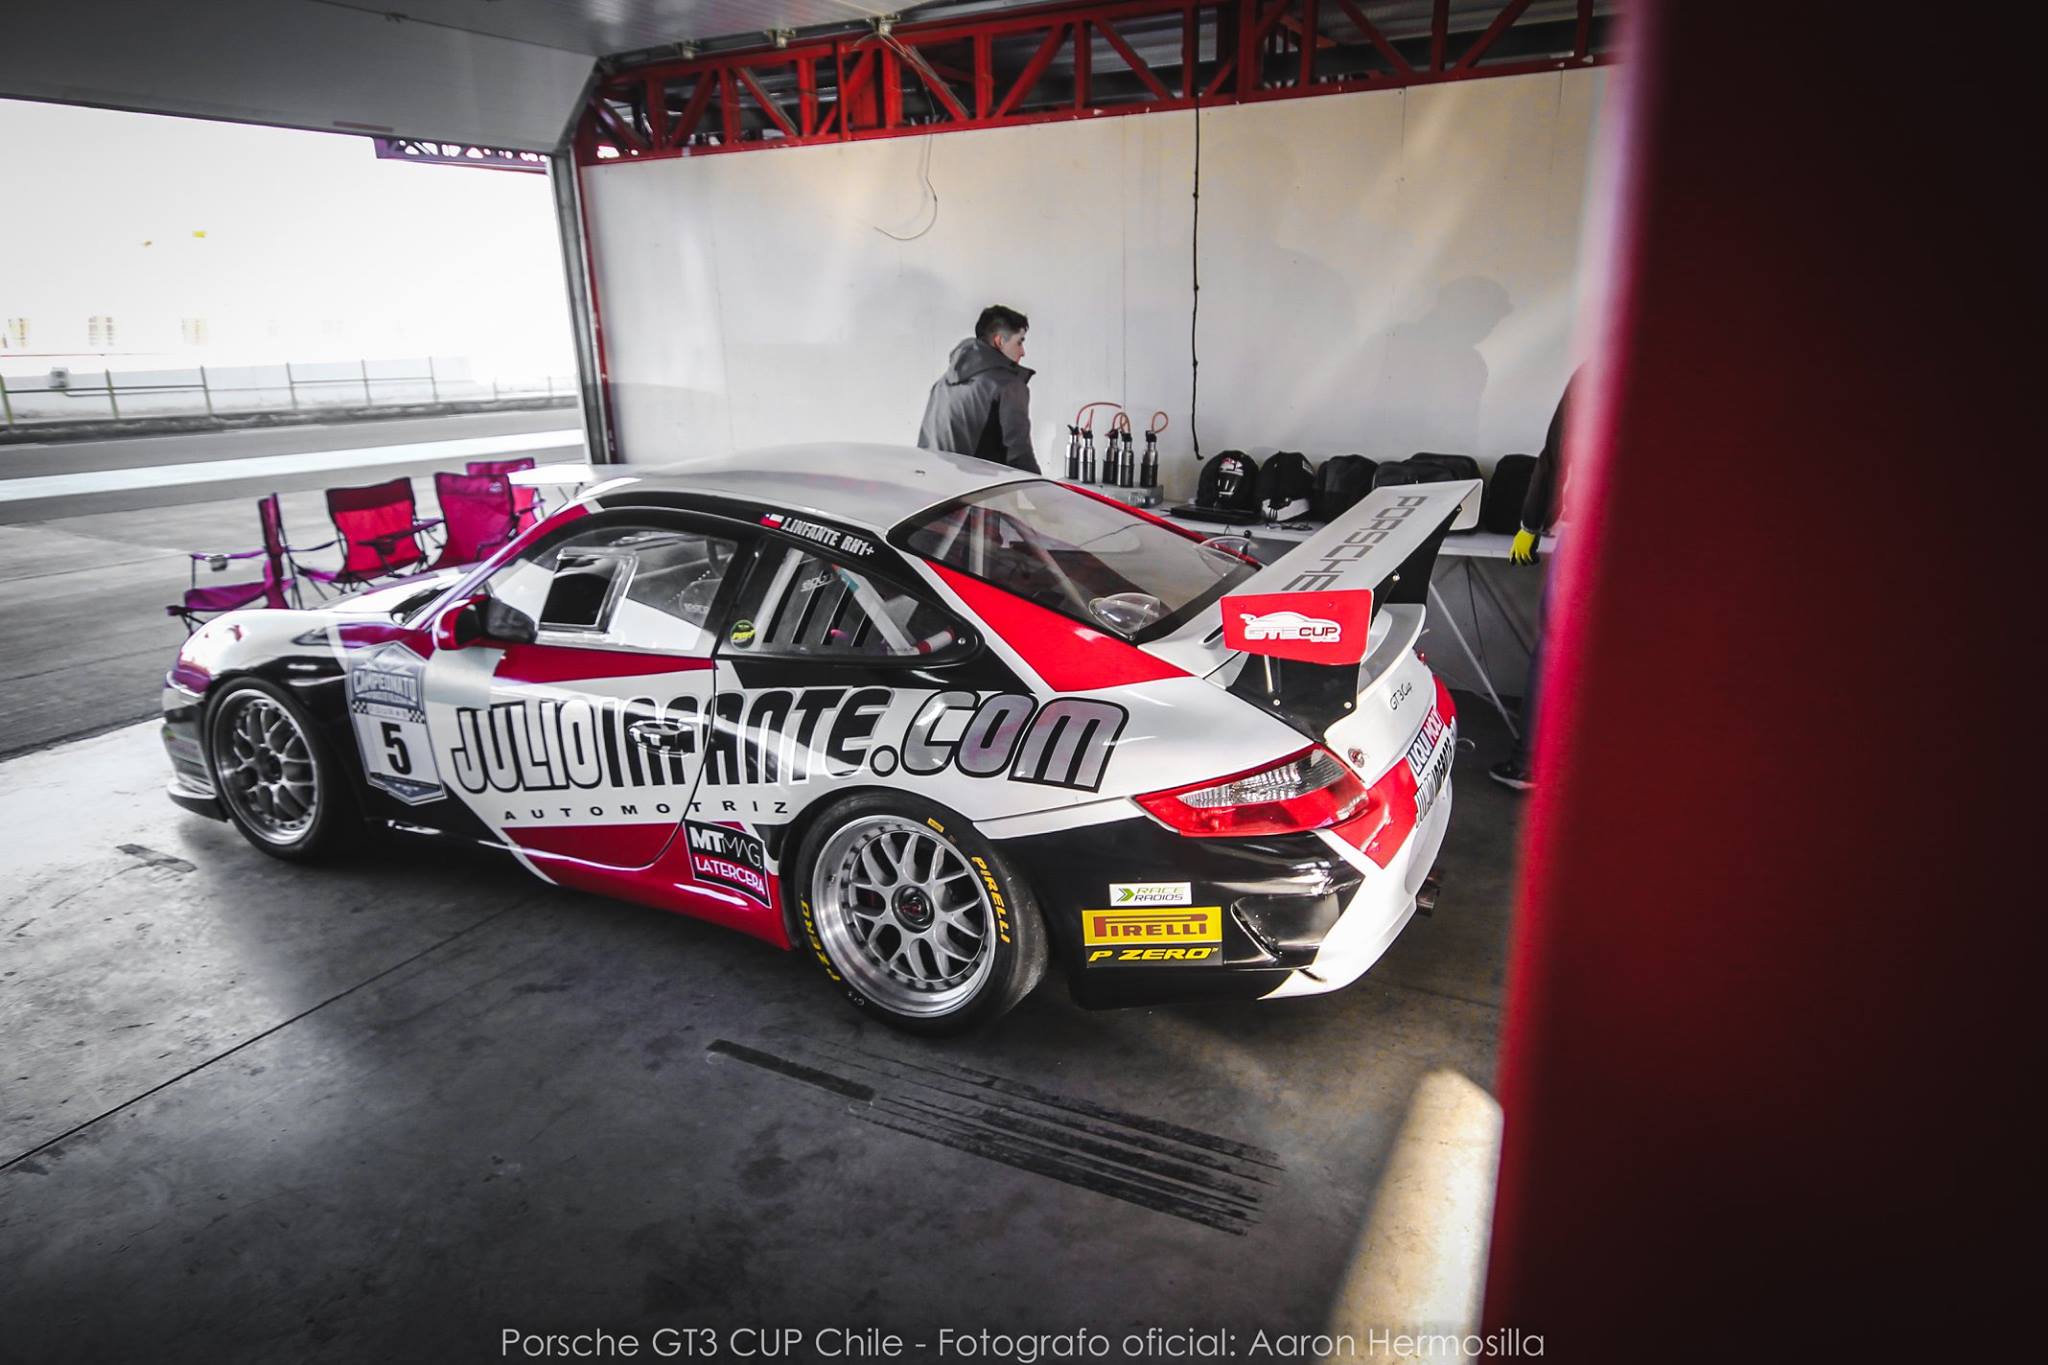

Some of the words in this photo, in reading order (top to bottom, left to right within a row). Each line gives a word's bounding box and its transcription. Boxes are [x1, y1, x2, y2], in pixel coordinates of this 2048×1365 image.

[1281, 496, 1428, 591] PORSCHE
[380, 721, 412, 775] 5
[504, 800, 789, 821] AUTOMOTRIZ
[971, 855, 1011, 944] PIRELLI
[1134, 894, 1183, 902] RADIOS
[1094, 914, 1208, 938] PIRELLI
[1089, 950, 1113, 962] P
